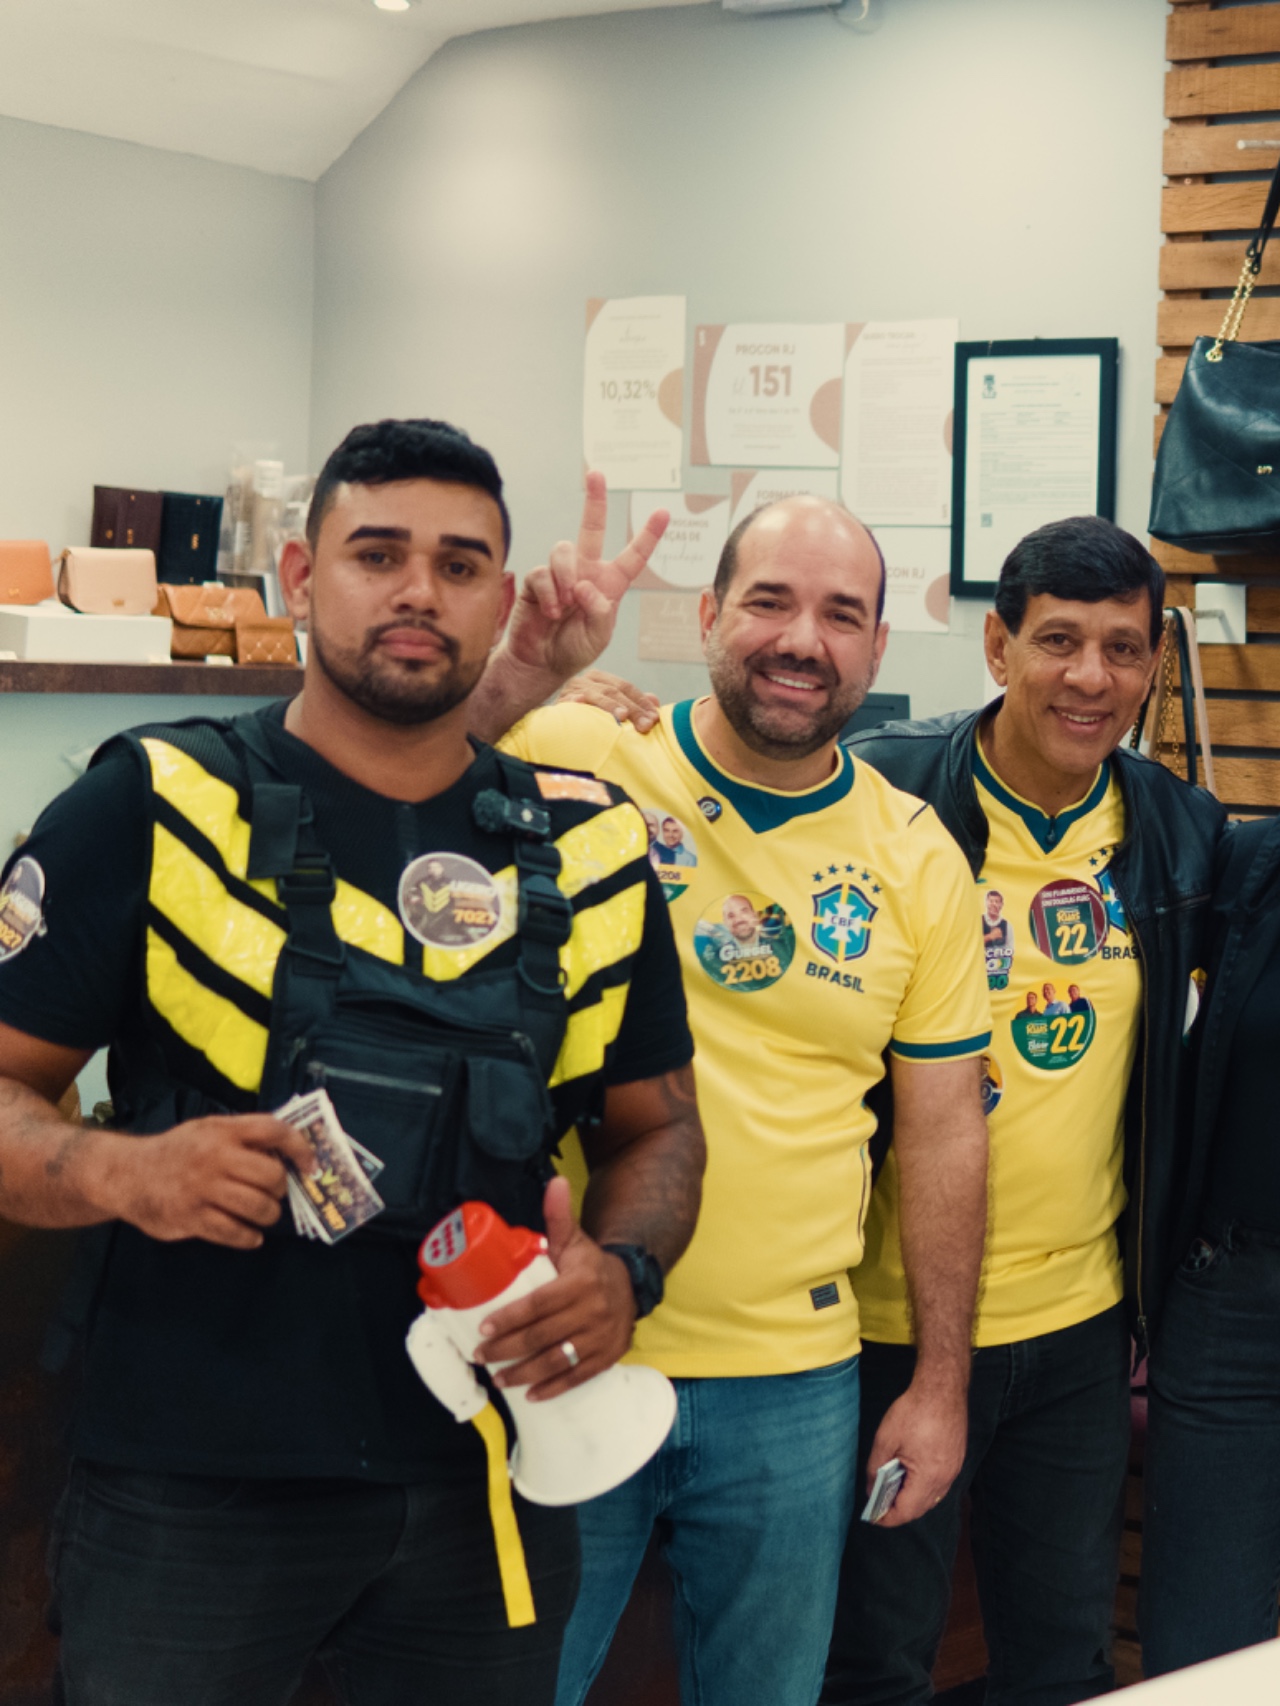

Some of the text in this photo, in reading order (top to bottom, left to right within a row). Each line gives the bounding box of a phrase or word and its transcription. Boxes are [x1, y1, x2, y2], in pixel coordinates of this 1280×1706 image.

[736, 344, 796, 356] PROCON RJ
[600, 380, 656, 402] 10,32%
[749, 365, 792, 398] 151
[886, 567, 909, 579] CON
[831, 915, 856, 928] CBF
[1055, 923, 1090, 958] 22
[1102, 946, 1138, 960] BRAS
[721, 955, 782, 985] 2208
[805, 961, 866, 994] BRASIL
[1050, 1015, 1086, 1054] 22
